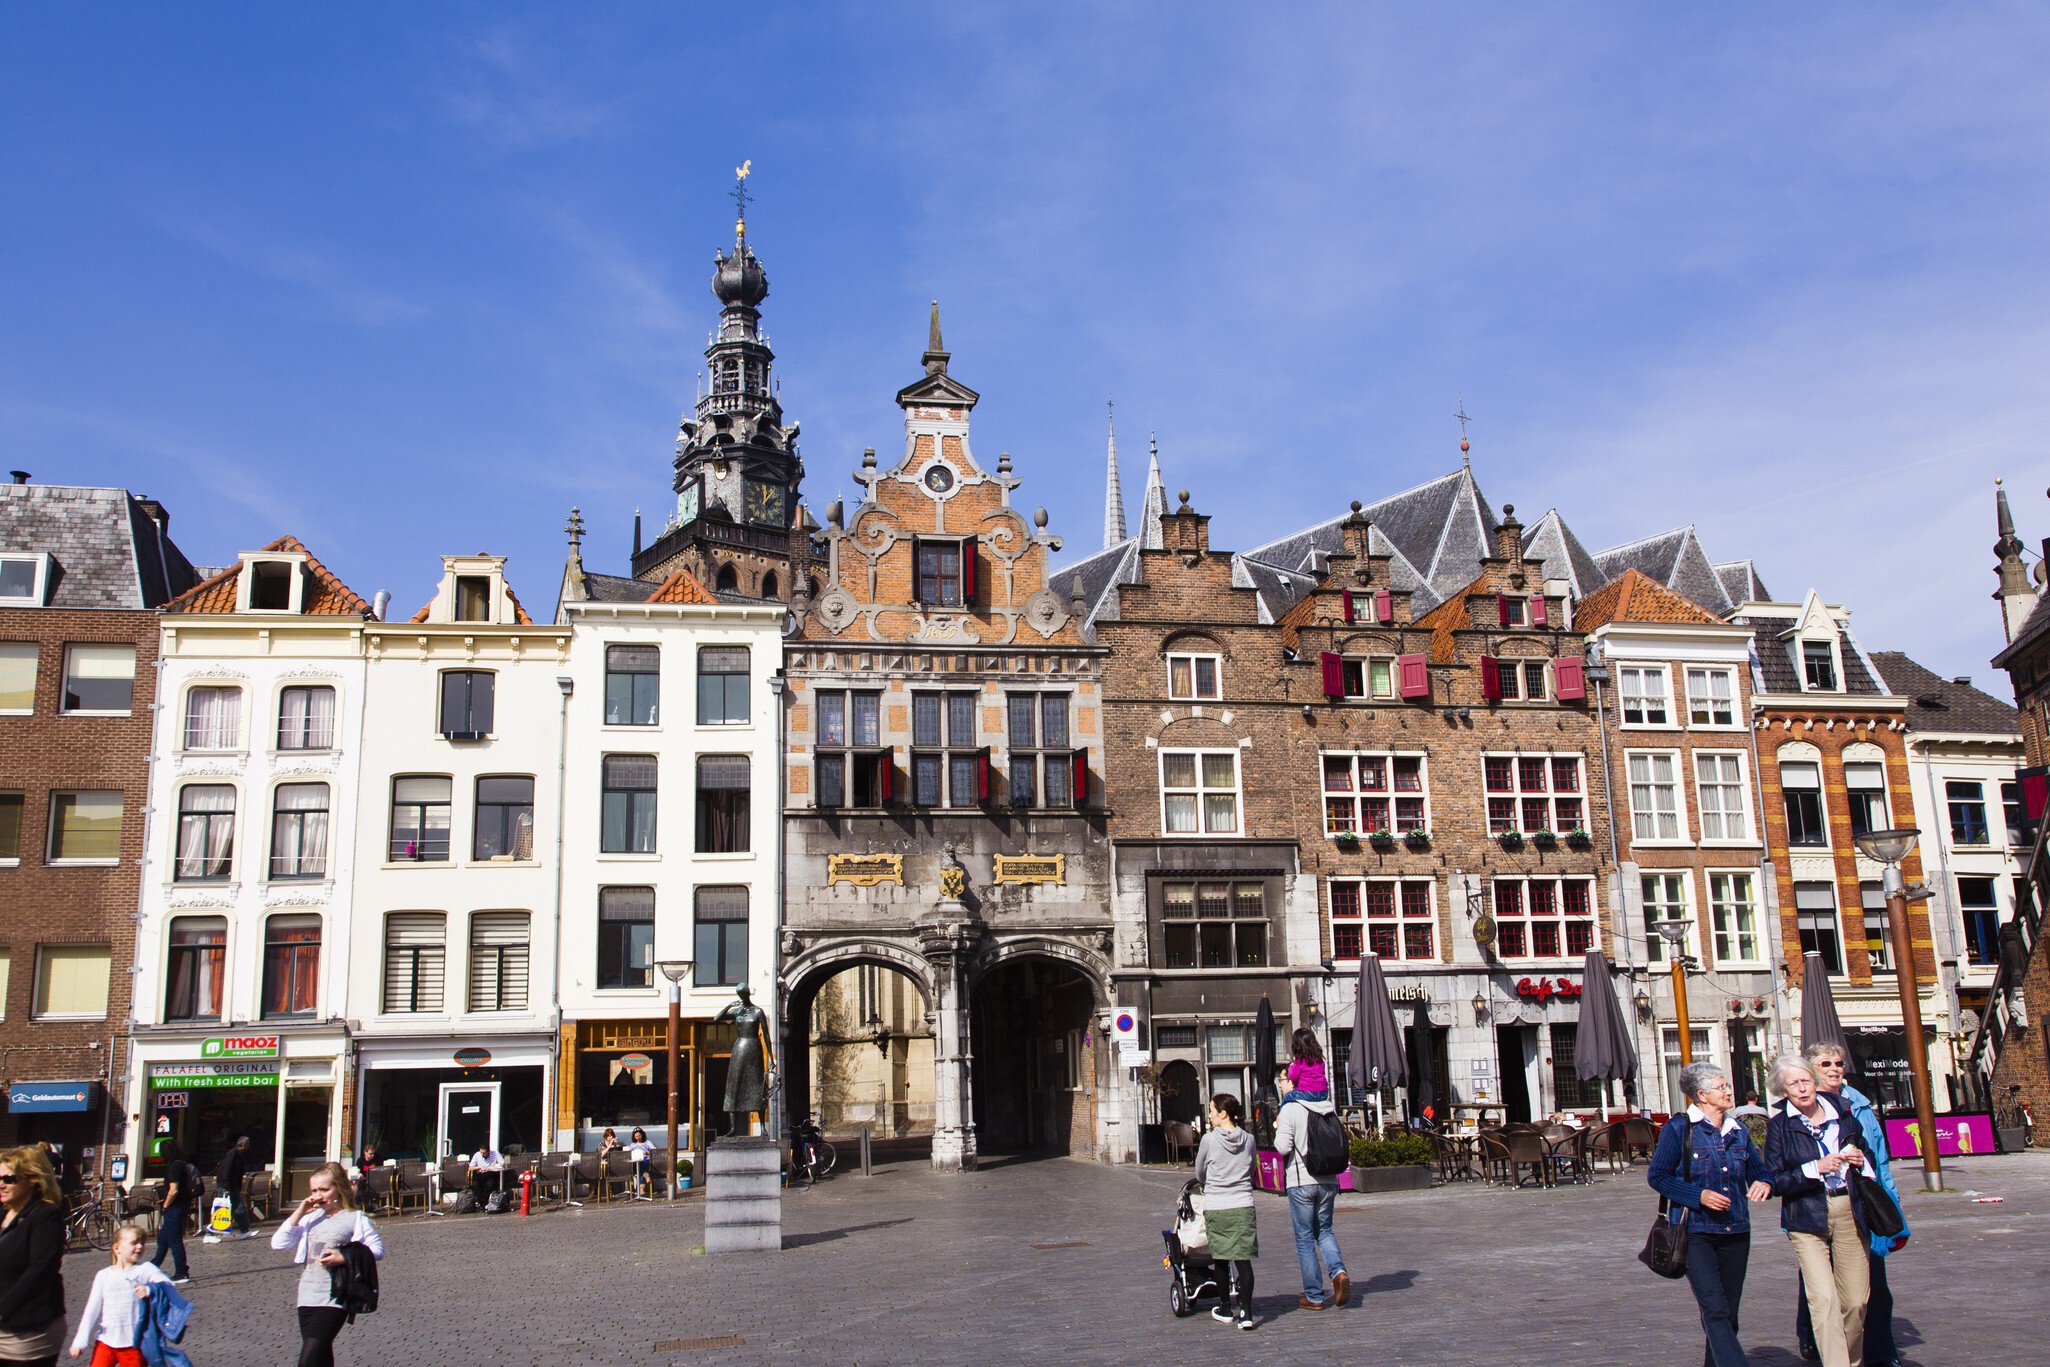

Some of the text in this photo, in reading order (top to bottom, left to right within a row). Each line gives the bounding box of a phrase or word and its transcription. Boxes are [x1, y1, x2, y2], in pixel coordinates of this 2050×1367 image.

[922, 627, 958, 639] 1605
[1516, 976, 1553, 1002] Café
[224, 1036, 277, 1049] maoz
[155, 1064, 275, 1075] FALAFEL ORIGINAL
[1865, 1059, 1909, 1069] MexiMode
[155, 1076, 274, 1088] With fresh salad bar
[159, 1094, 187, 1107] OPEN
